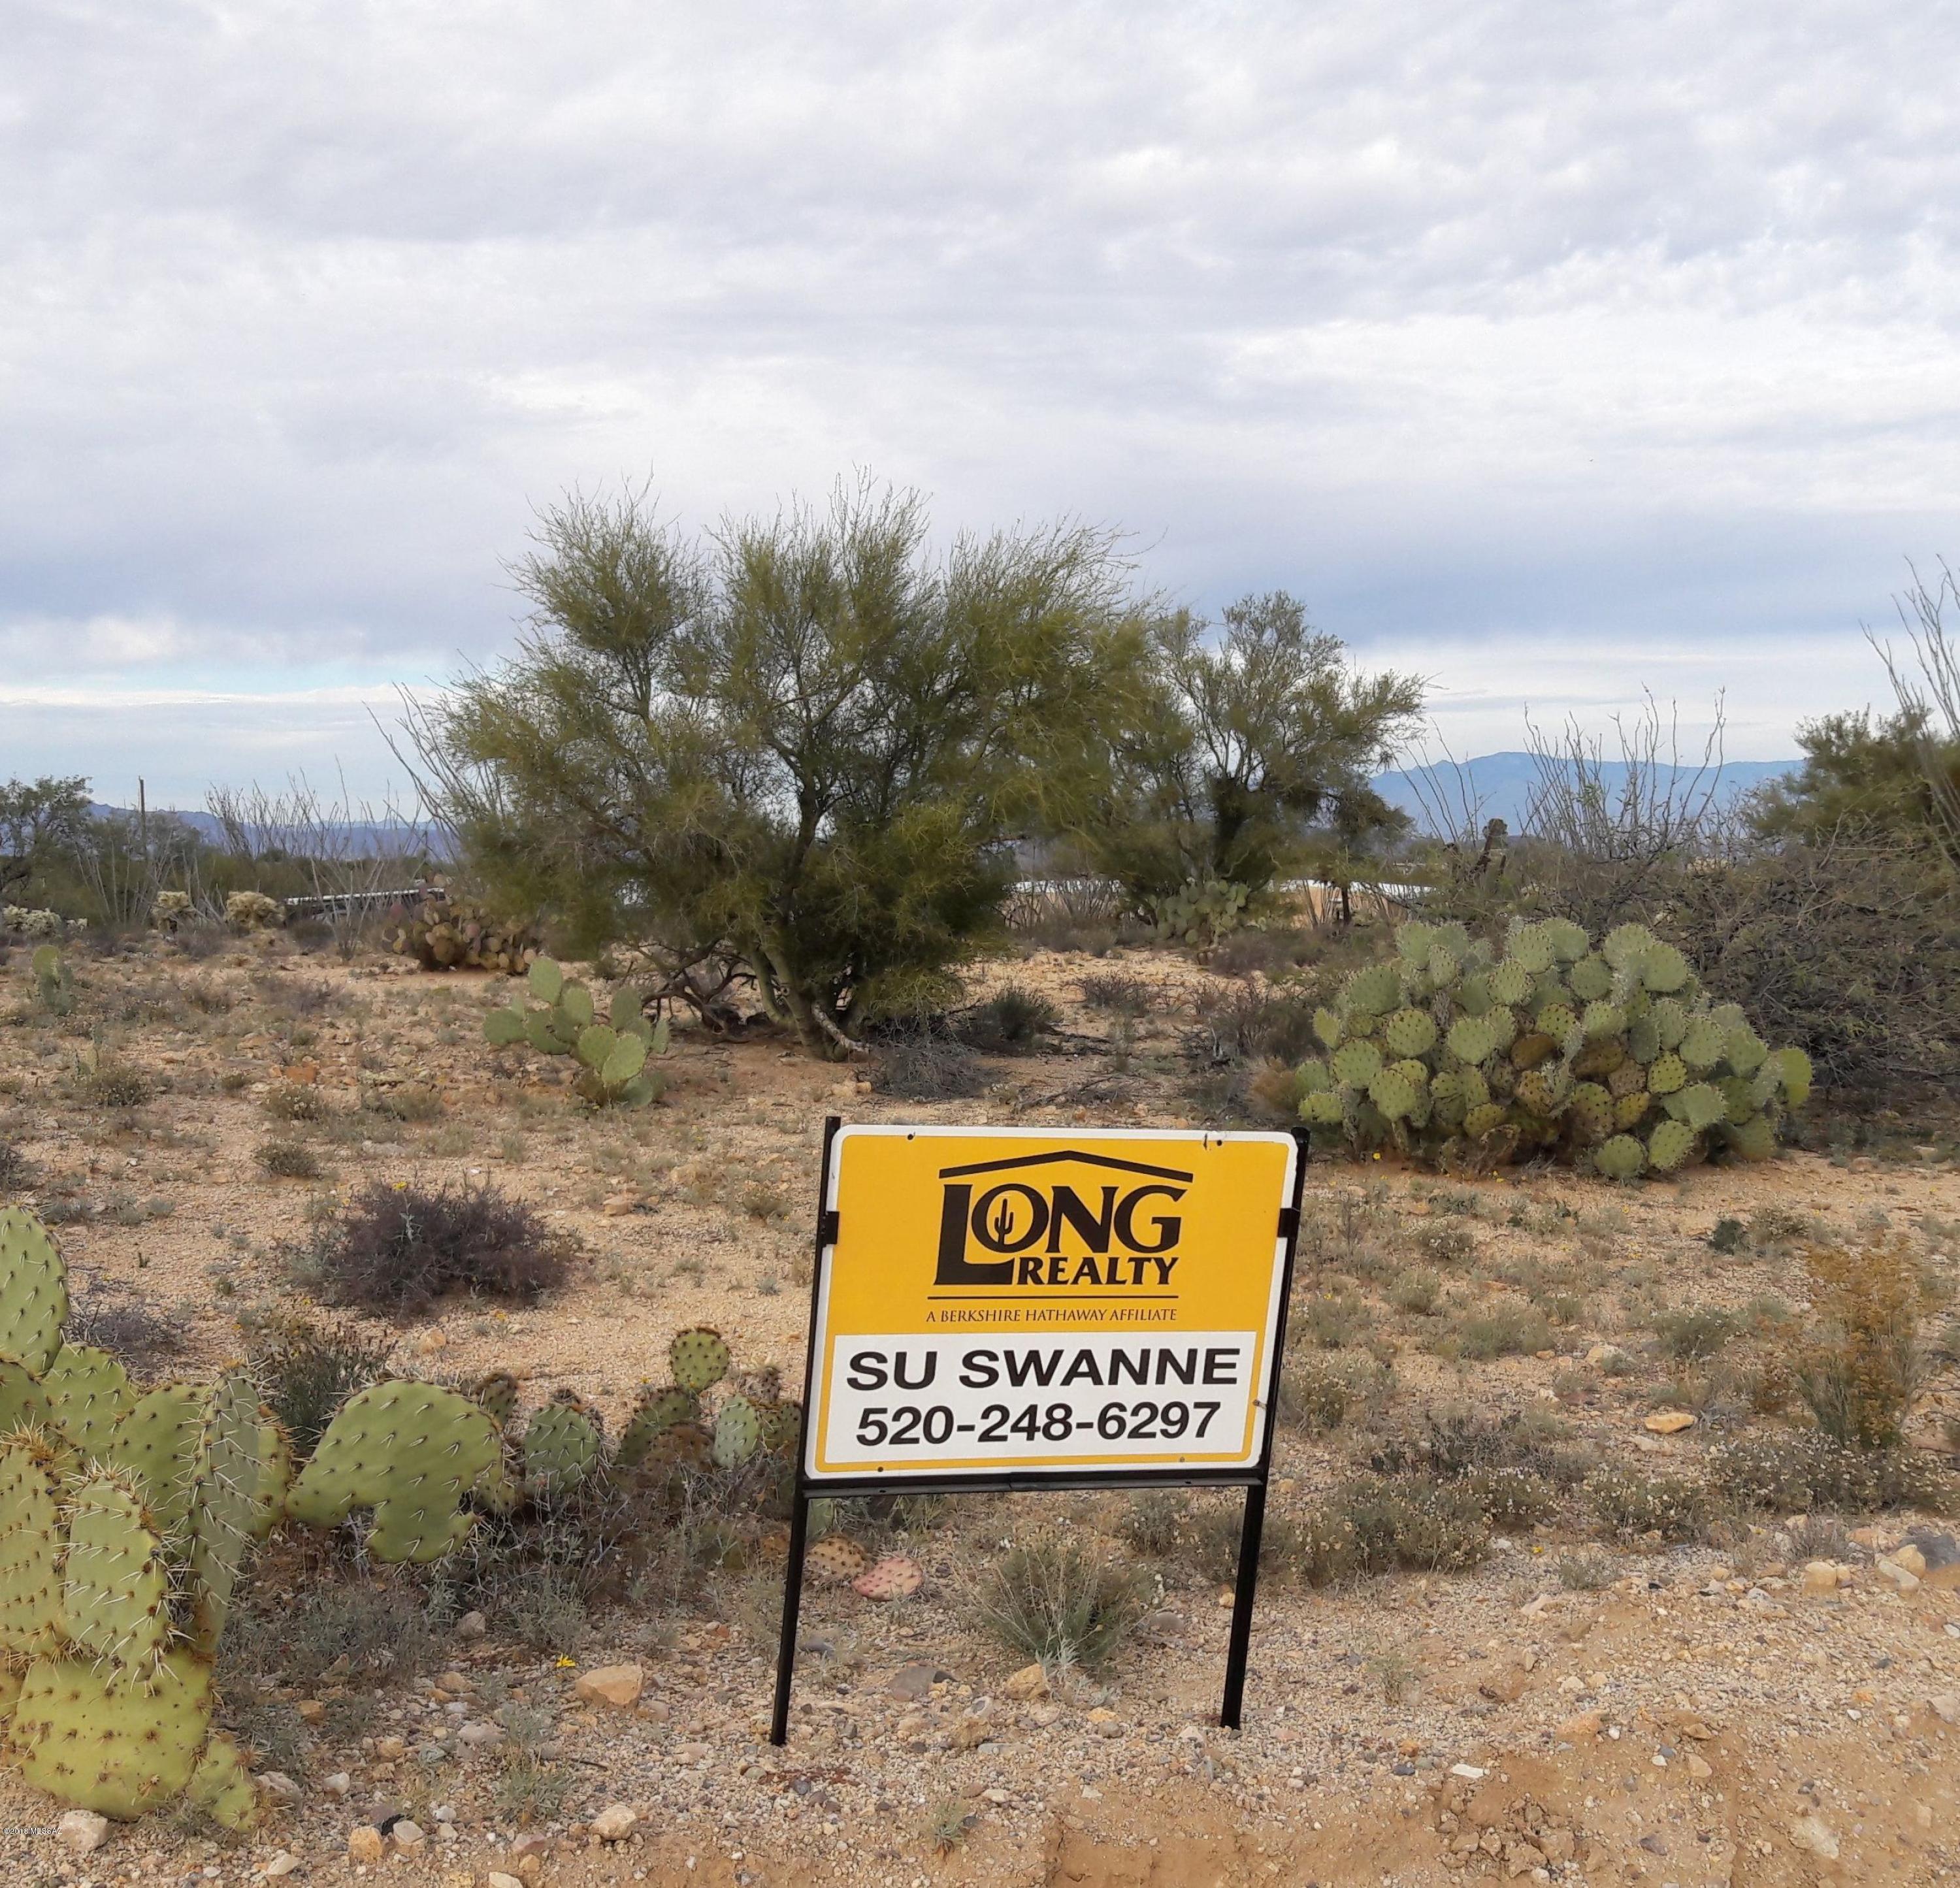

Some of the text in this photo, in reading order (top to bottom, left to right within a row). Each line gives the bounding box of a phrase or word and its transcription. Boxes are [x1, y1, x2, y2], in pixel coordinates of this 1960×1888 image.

[934, 1183, 1187, 1286] LONG
[1017, 1256, 1179, 1286] REALTY
[926, 1309, 1177, 1322] A BERKSHIRE HATHAWAY AFFILIATE
[847, 1348, 1240, 1391] SU SWANNE
[856, 1401, 1221, 1446] 520-248-6297
